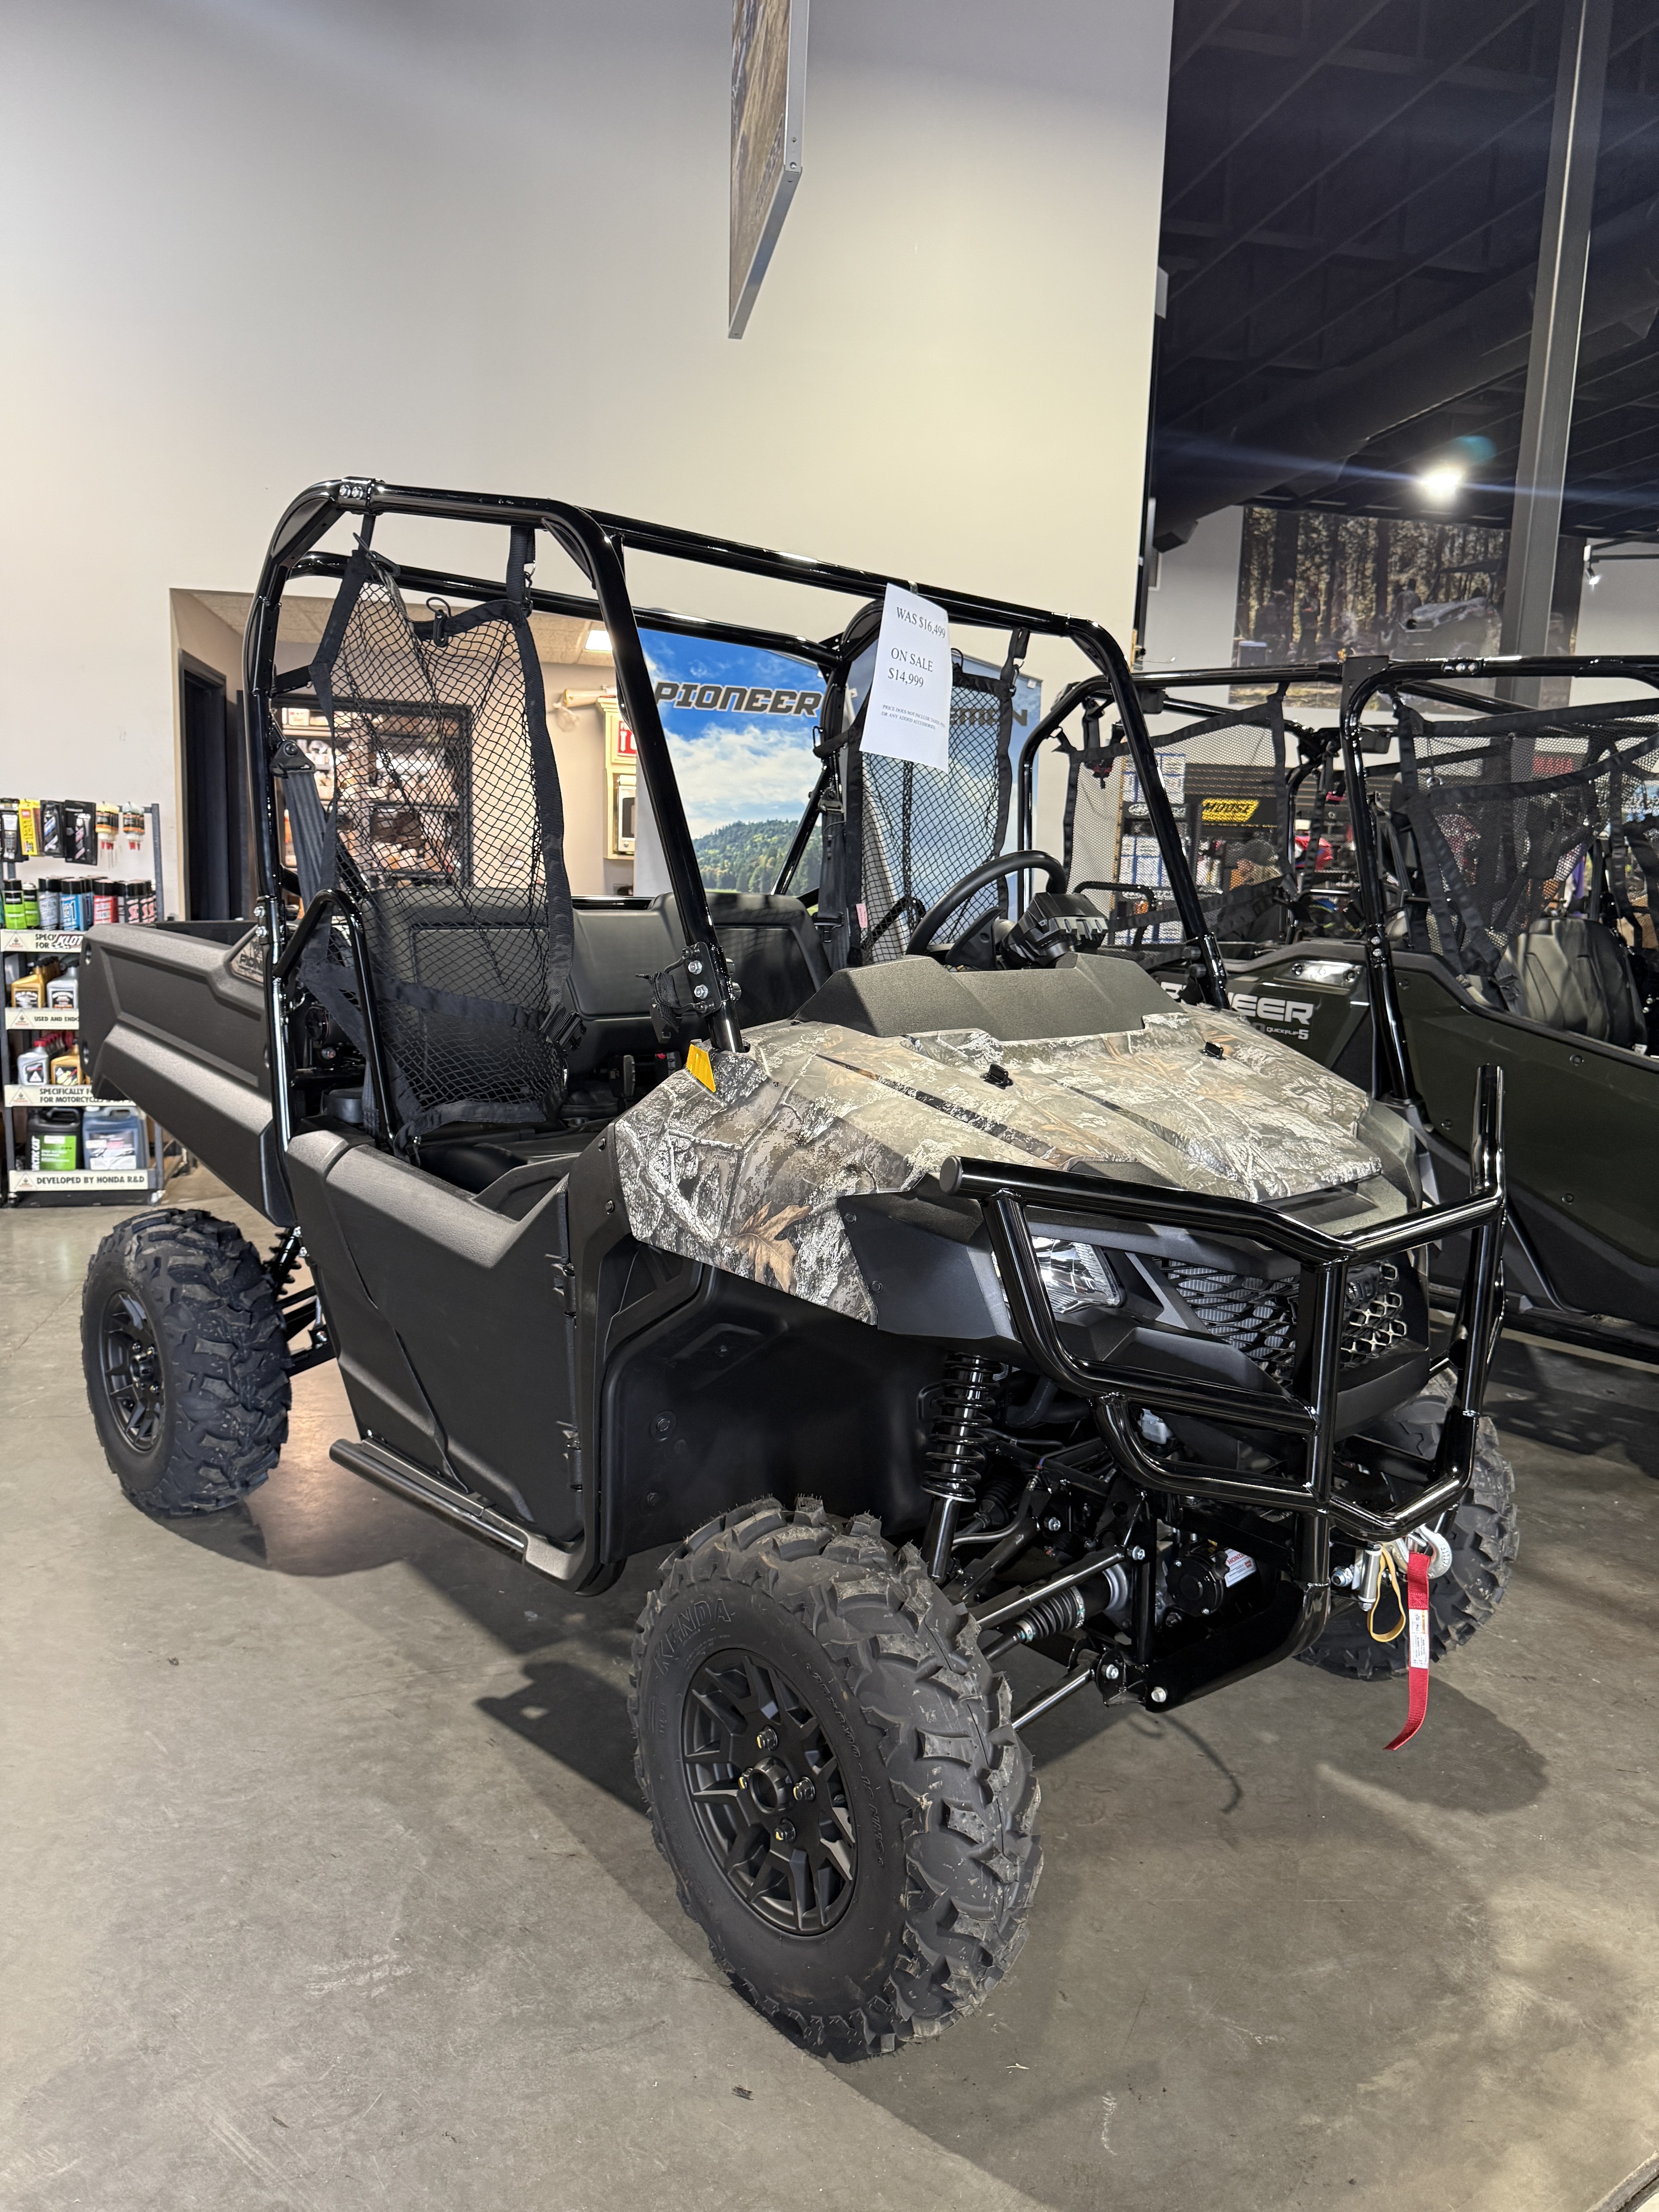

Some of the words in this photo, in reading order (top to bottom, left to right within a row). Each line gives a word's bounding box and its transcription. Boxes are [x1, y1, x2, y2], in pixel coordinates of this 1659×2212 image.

[897, 607, 917, 625] WAS
[919, 617, 946, 638] $16,499
[891, 647, 907, 662] ON
[910, 653, 933, 672] SALE
[888, 667, 924, 687] $14,999
[654, 682, 823, 717] PIONEER
[654, 1599, 732, 1676] KENDA
